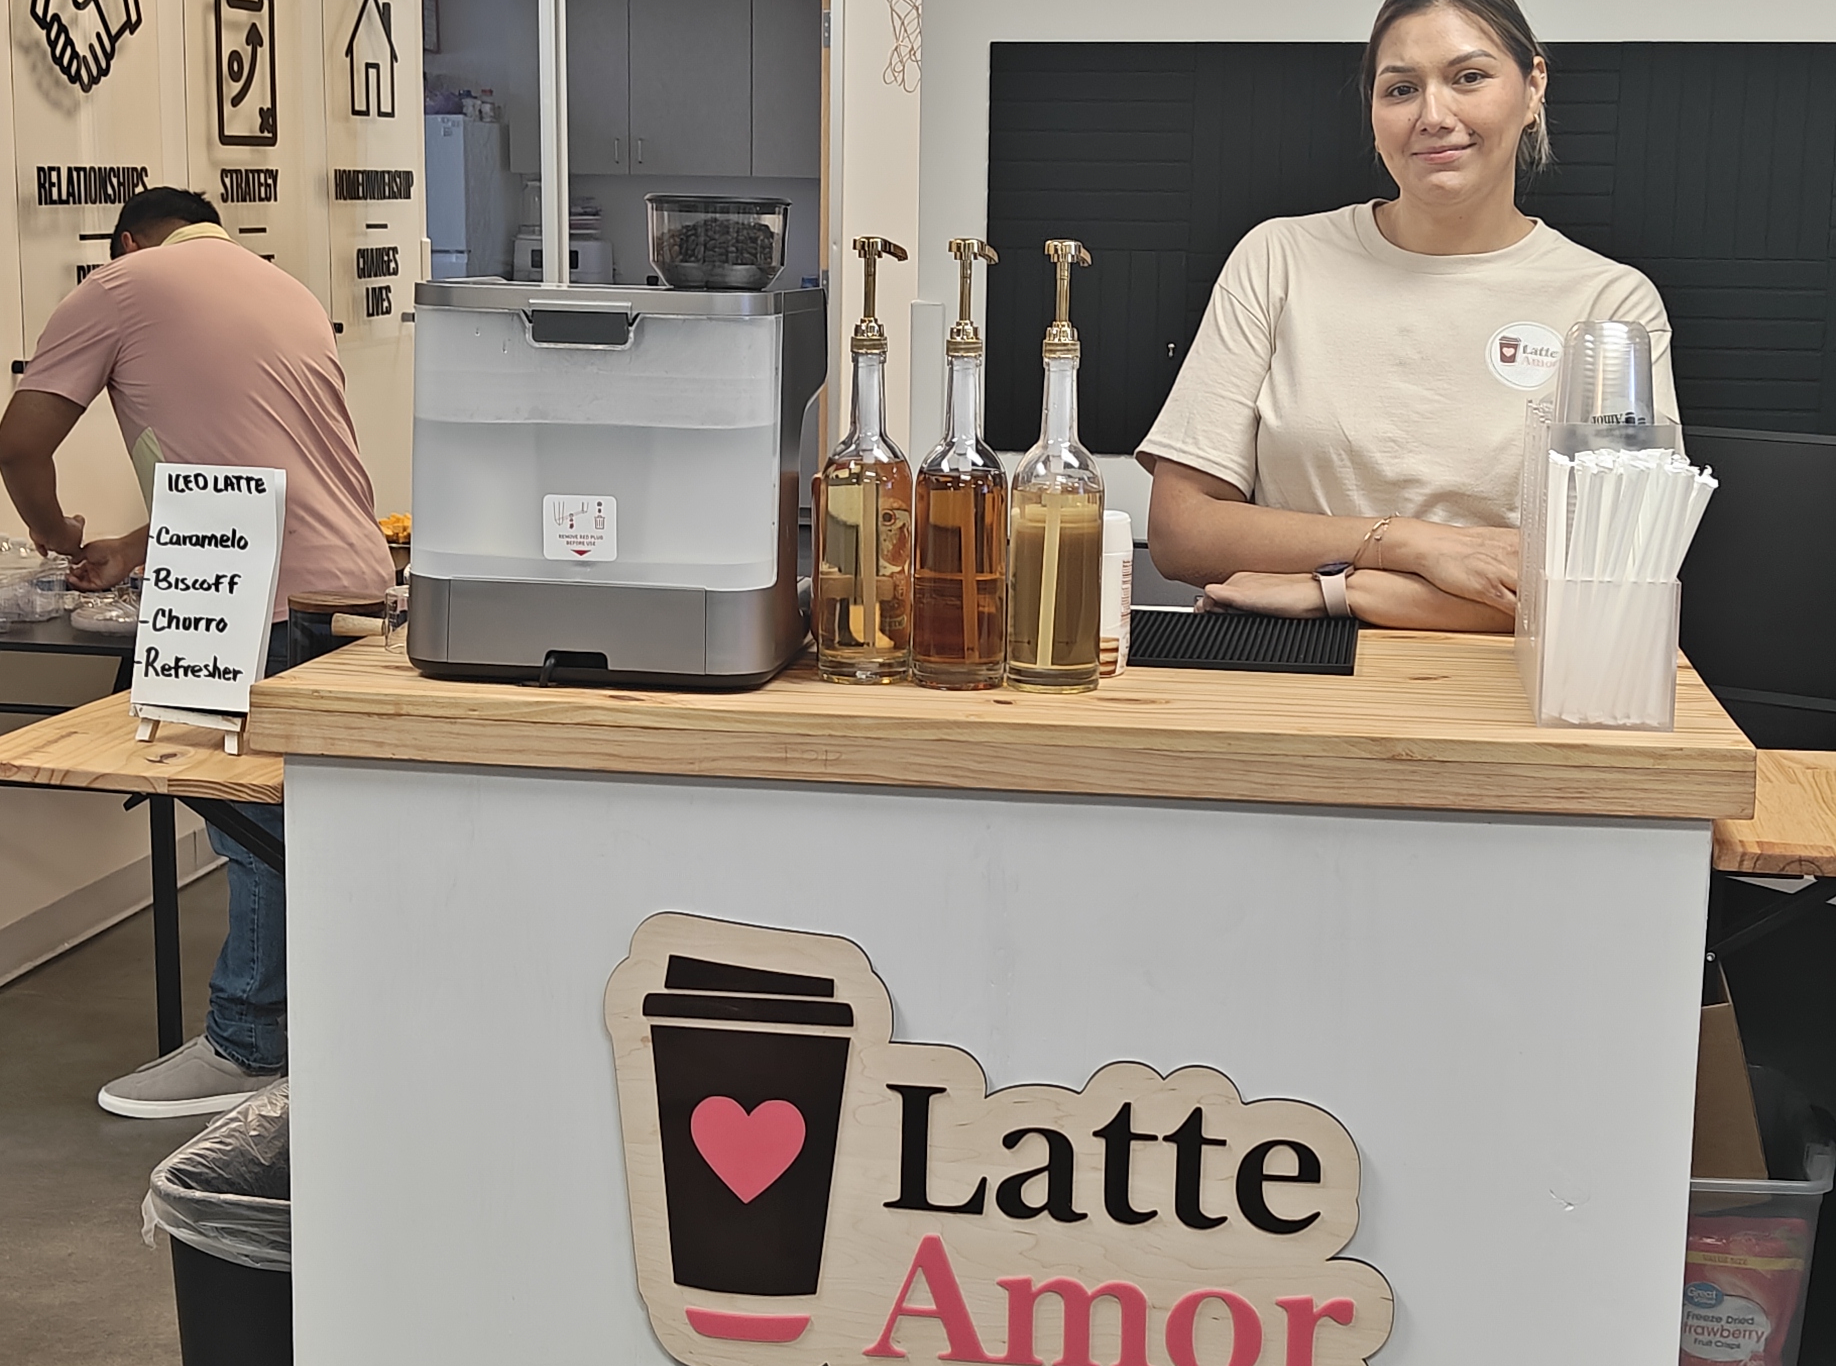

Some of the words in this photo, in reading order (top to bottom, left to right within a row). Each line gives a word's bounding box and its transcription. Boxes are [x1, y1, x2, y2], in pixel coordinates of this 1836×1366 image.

[36, 165, 149, 205] RELATIONSHIPS
[220, 168, 278, 203] STRATEGY
[334, 169, 414, 201] HOMEOWNERSHIP
[356, 246, 399, 279] CHANGES
[365, 285, 392, 317] LIVES
[1522, 344, 1559, 358] Latte
[167, 472, 209, 493] ICED
[213, 474, 267, 495] LATTE
[883, 1083, 1323, 1235] Latte
[1687, 1287, 1717, 1299] Great
[1686, 1310, 1723, 1324] Freeze
[1725, 1315, 1755, 1326] Dried
[1683, 1321, 1765, 1343] trawberry
[1693, 1337, 1713, 1347] Fruit
